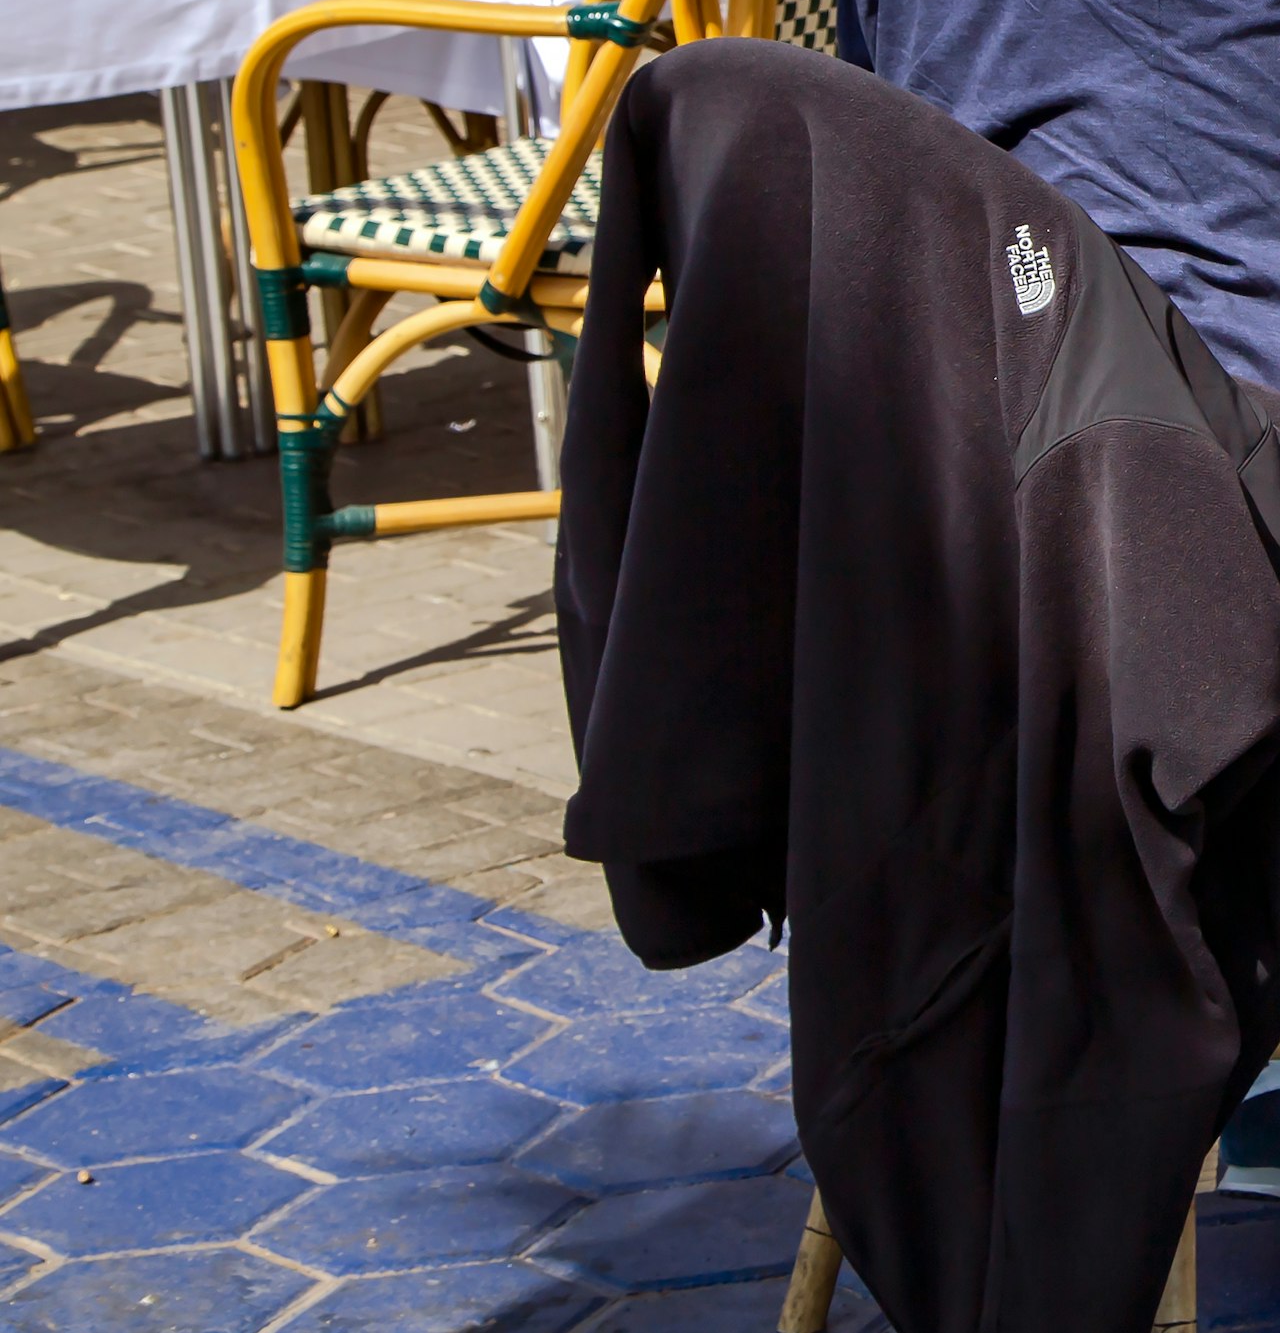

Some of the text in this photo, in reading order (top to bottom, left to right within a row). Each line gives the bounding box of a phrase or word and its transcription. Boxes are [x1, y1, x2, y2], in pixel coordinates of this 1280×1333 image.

[1005, 244, 1029, 287] FACE
[1014, 223, 1042, 284] NORTH
[1034, 246, 1054, 282] THE
